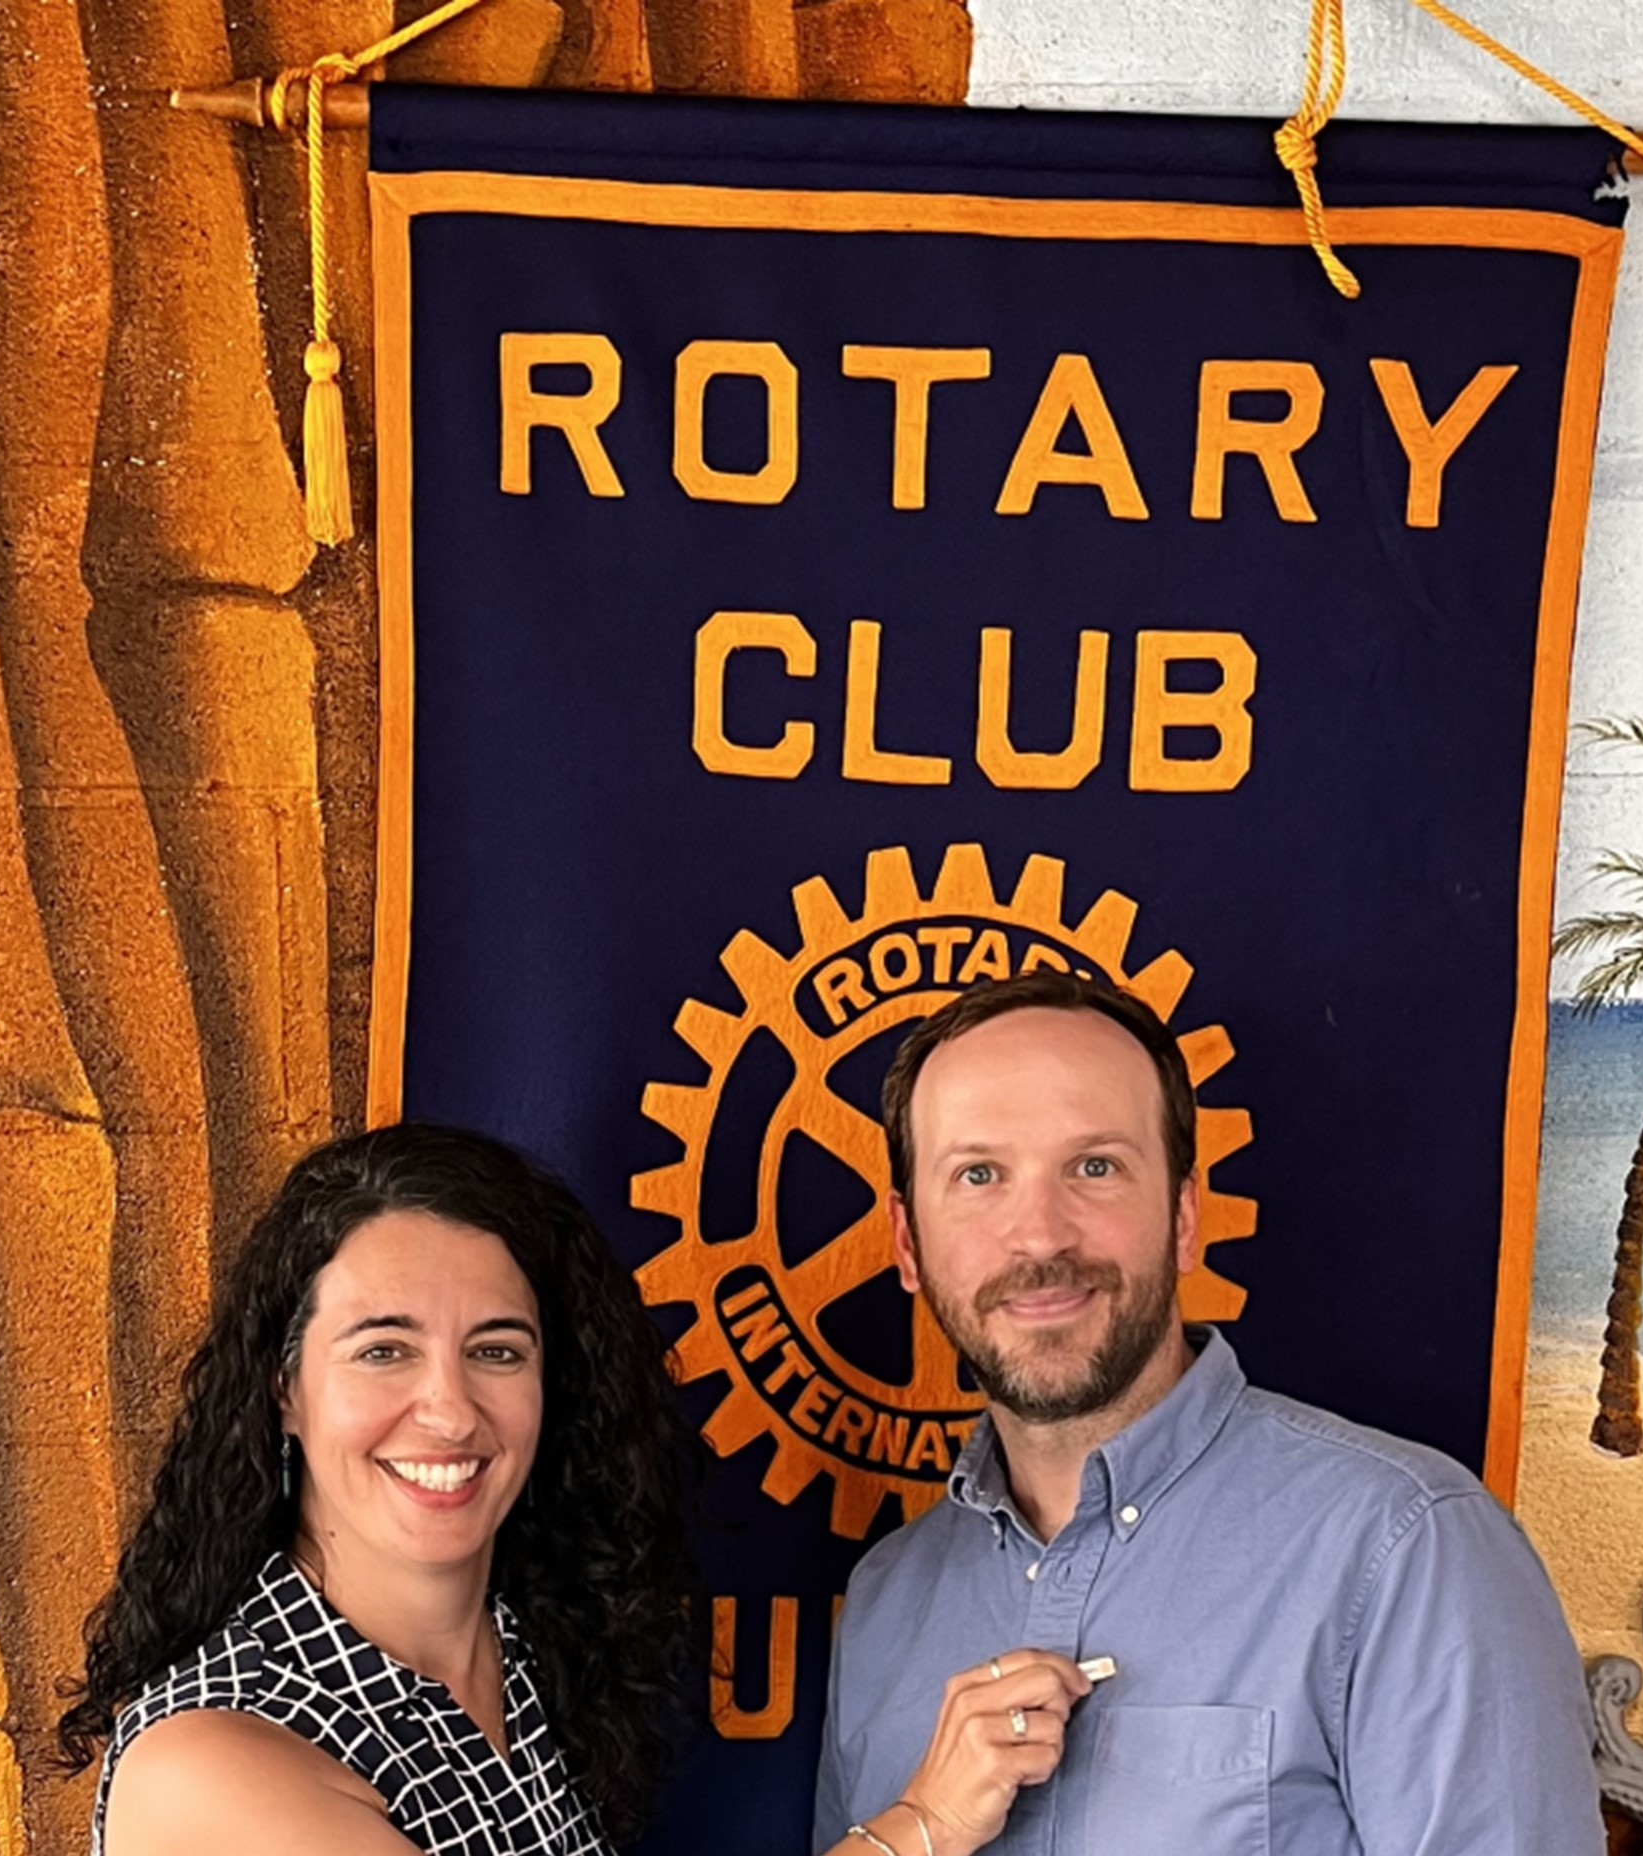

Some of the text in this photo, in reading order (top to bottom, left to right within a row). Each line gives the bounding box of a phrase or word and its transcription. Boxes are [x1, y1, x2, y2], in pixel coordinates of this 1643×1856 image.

[499, 332, 1519, 529] ROTARY
[691, 611, 1258, 793] CLUB
[812, 926, 1092, 1026] ROTA
